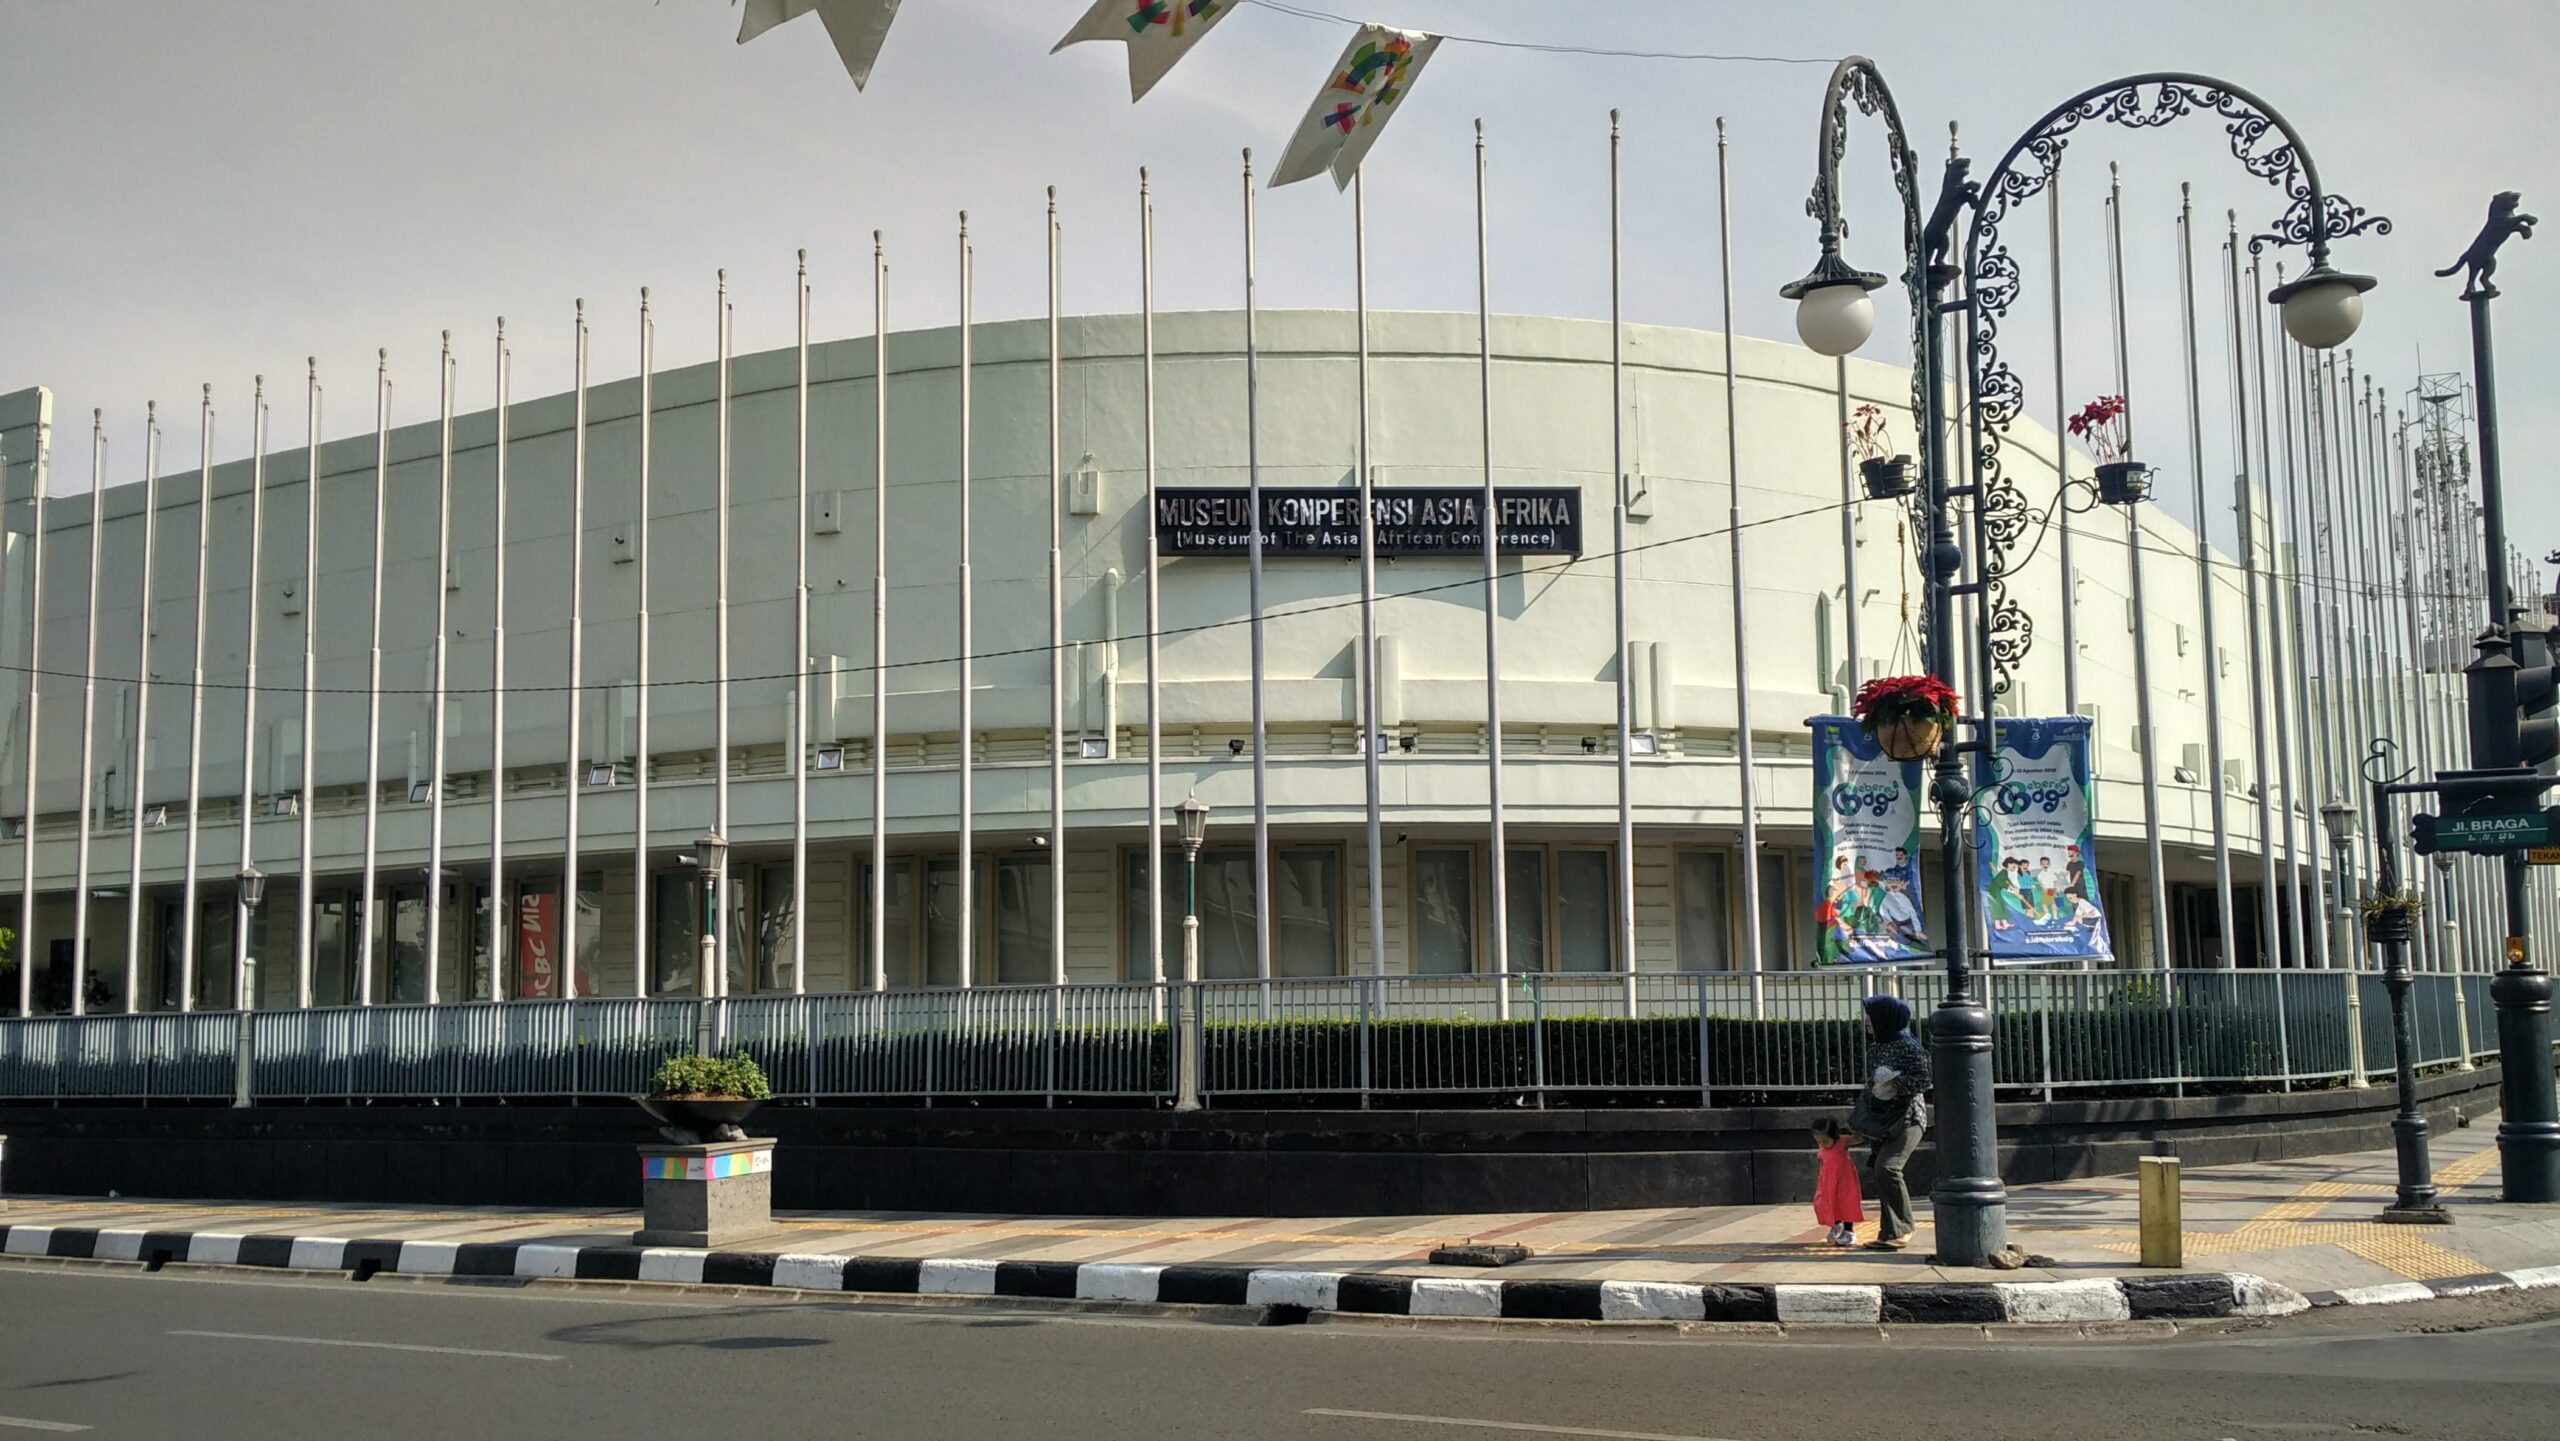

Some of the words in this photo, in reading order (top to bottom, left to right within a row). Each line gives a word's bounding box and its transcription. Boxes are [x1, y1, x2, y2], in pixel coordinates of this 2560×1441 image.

[1268, 498, 1413, 526] KONPERNSI
[1421, 498, 1479, 526] ASIA
[1260, 531, 1277, 545] of
[1285, 531, 1316, 545] The
[1377, 529, 1443, 545] African
[1451, 530, 1555, 548] Conrence)
[2471, 818, 2530, 831] BRAGA
